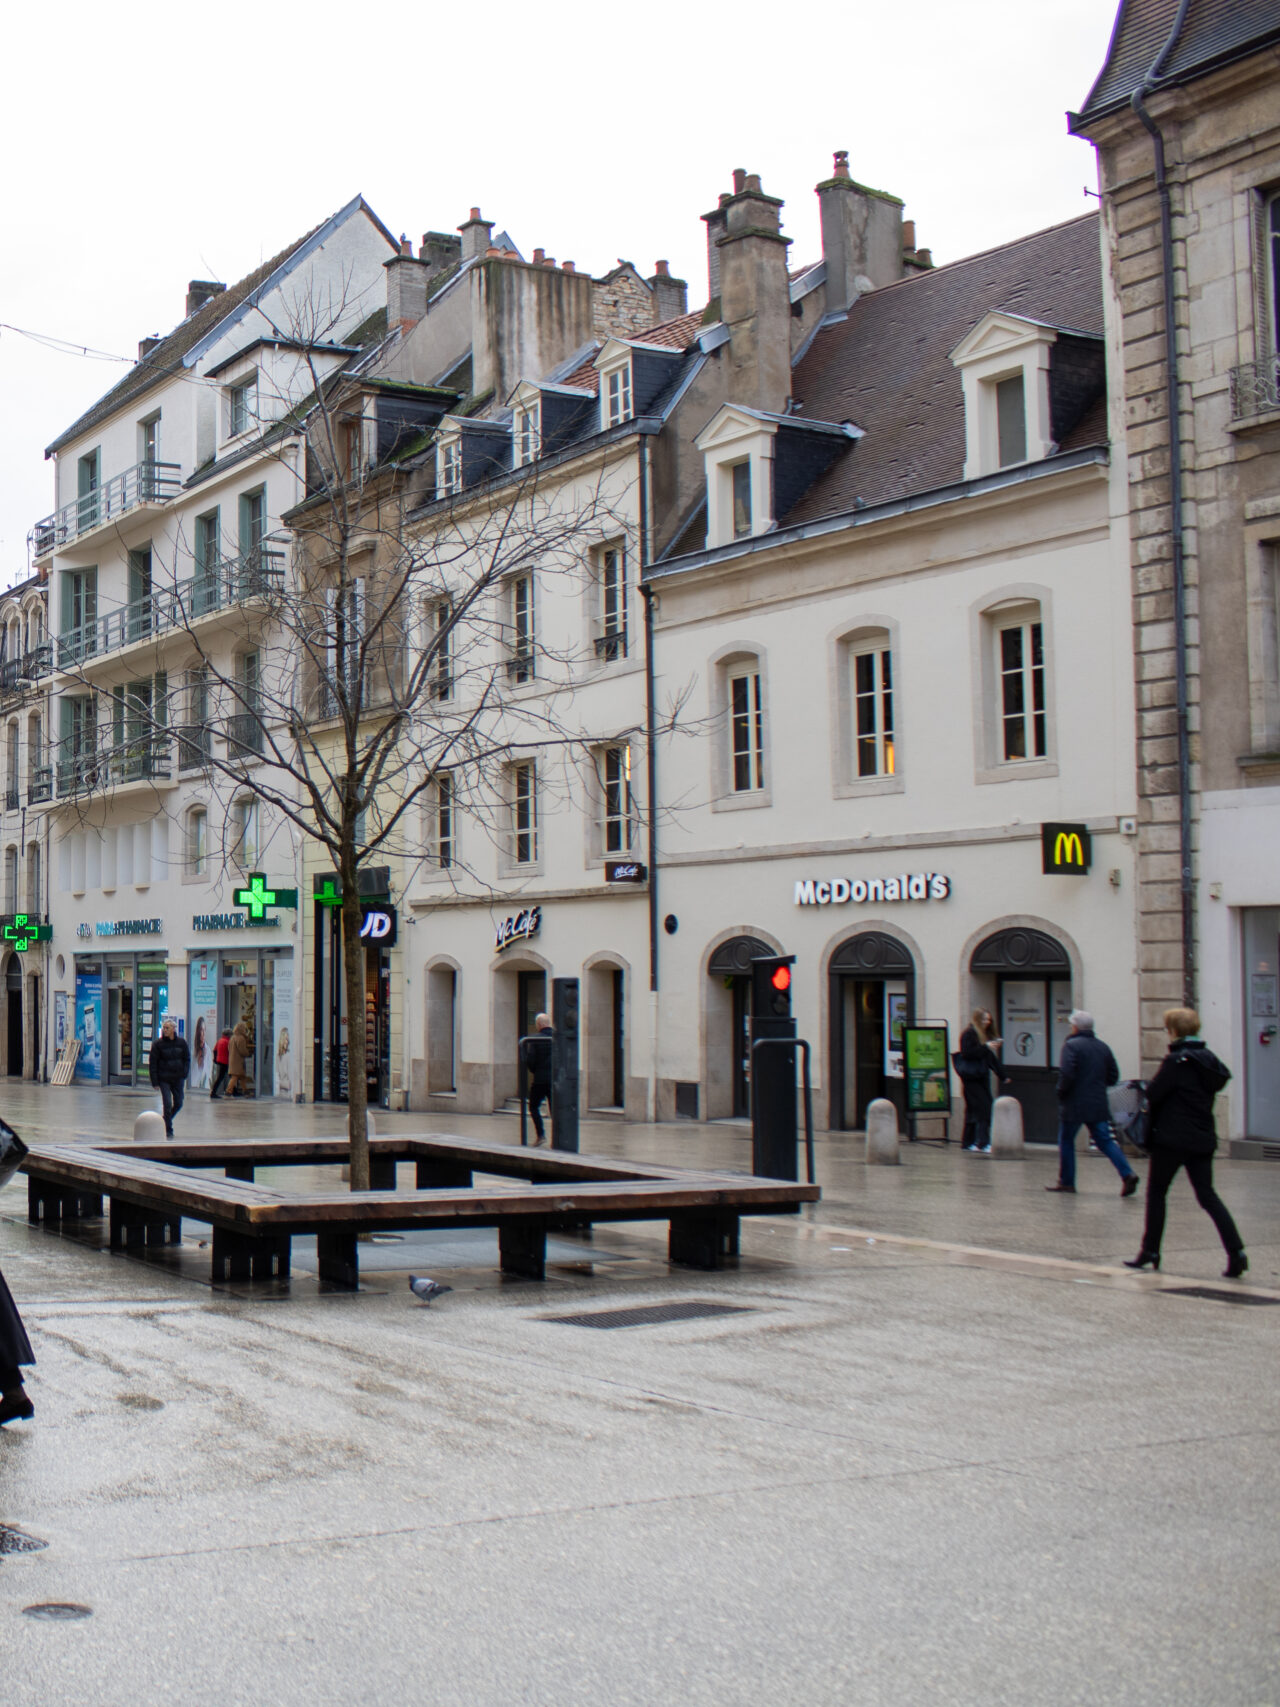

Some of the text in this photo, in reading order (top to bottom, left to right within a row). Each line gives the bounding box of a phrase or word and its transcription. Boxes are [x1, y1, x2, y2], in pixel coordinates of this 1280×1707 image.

[614, 863, 639, 879] McCafé
[794, 872, 951, 905] McDonald's
[192, 912, 246, 931] PHARMACIE
[360, 911, 392, 938] JD
[495, 905, 542, 952] McCafé
